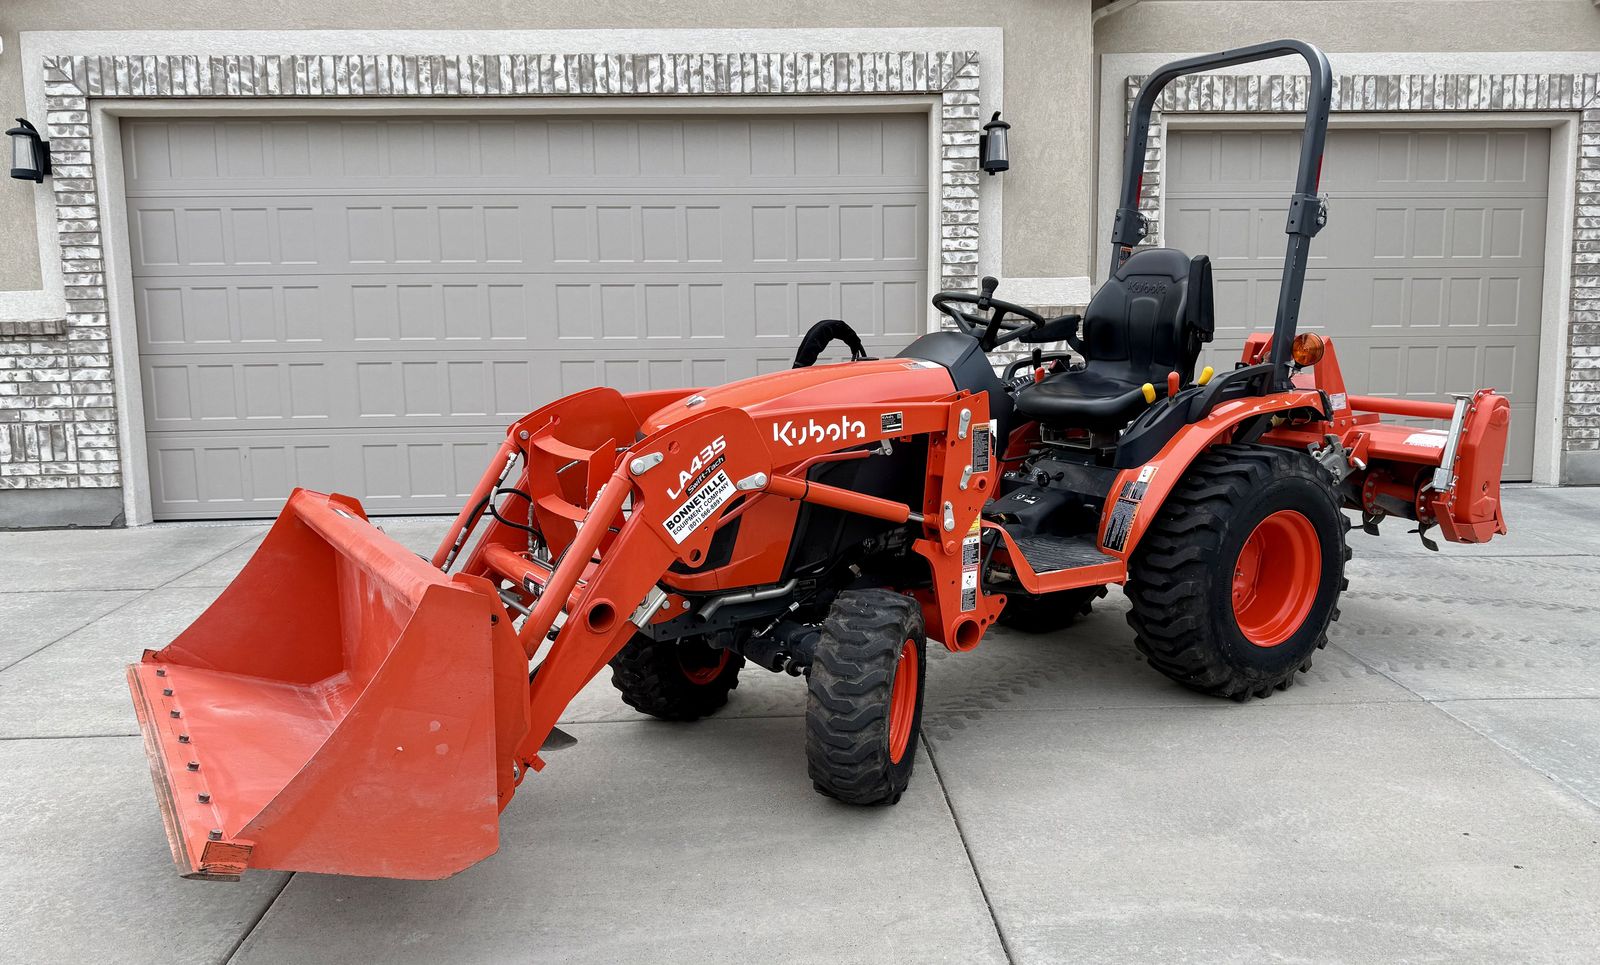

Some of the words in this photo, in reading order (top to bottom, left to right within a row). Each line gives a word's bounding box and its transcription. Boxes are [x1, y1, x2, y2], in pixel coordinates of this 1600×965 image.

[773, 416, 865, 446] Kubota
[667, 435, 726, 500] LA435
[687, 457, 724, 494] Swift-Tach
[666, 473, 726, 530] BONNEVILLE
[673, 506, 704, 535] EQUIPMENT
[704, 481, 729, 507] COMPANY
[688, 518, 702, 531] (801)
